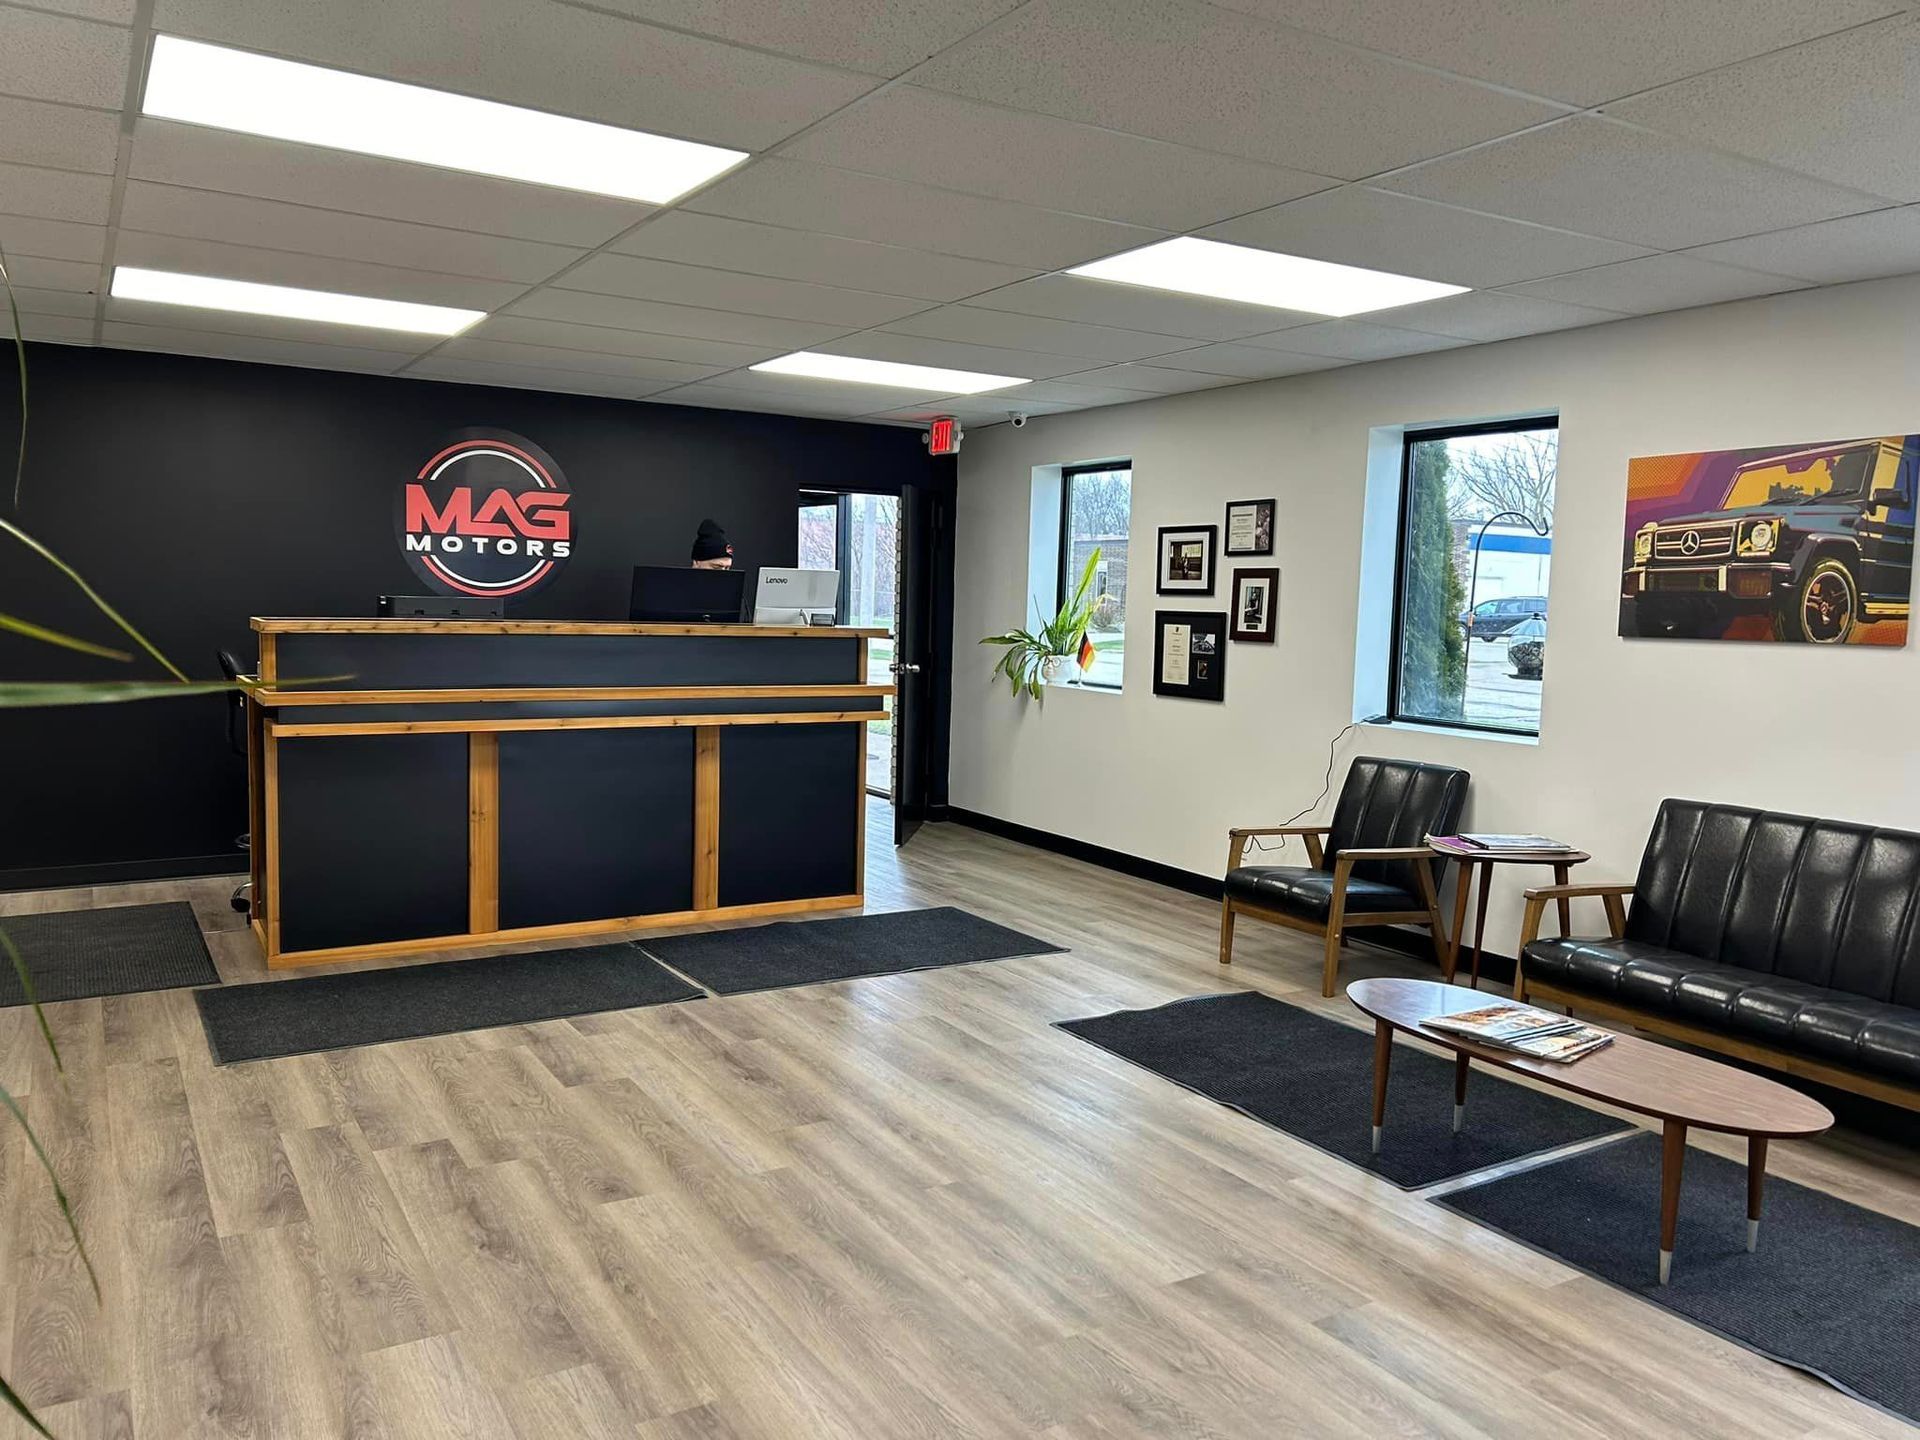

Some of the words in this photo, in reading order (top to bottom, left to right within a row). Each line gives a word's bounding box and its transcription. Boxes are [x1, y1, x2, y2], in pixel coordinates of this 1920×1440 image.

[932, 420, 952, 452] EXIT
[405, 484, 570, 540] MAG
[406, 534, 570, 558] MOTORS
[765, 576, 788, 584] Lenovo
